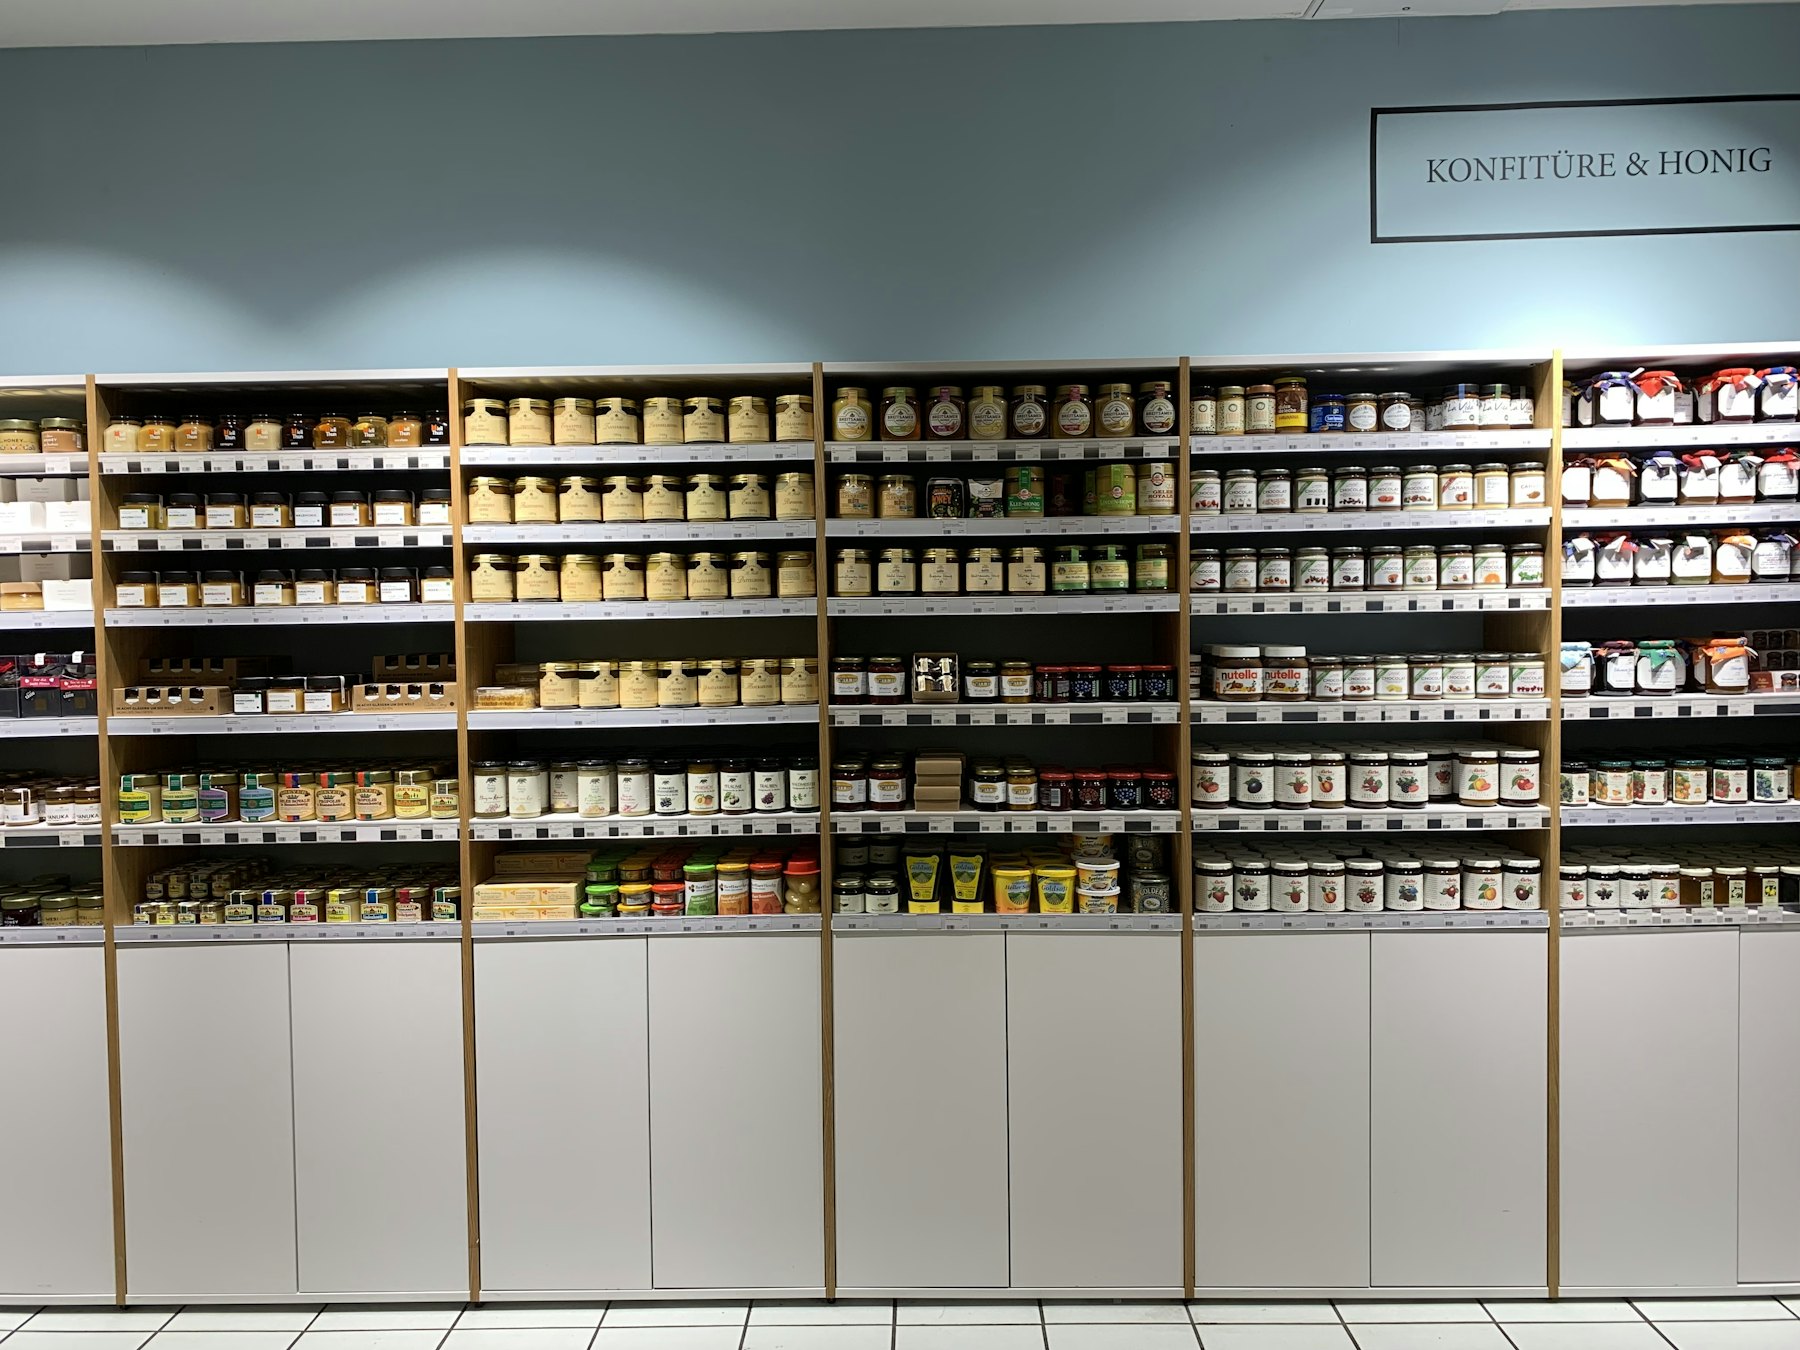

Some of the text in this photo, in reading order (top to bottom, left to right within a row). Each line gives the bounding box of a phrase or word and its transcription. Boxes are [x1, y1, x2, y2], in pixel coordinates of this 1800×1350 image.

[1426, 147, 1772, 184] KONFITÜRE & HONIG
[1221, 669, 1258, 680] nutella
[1265, 669, 1301, 680] nutella
